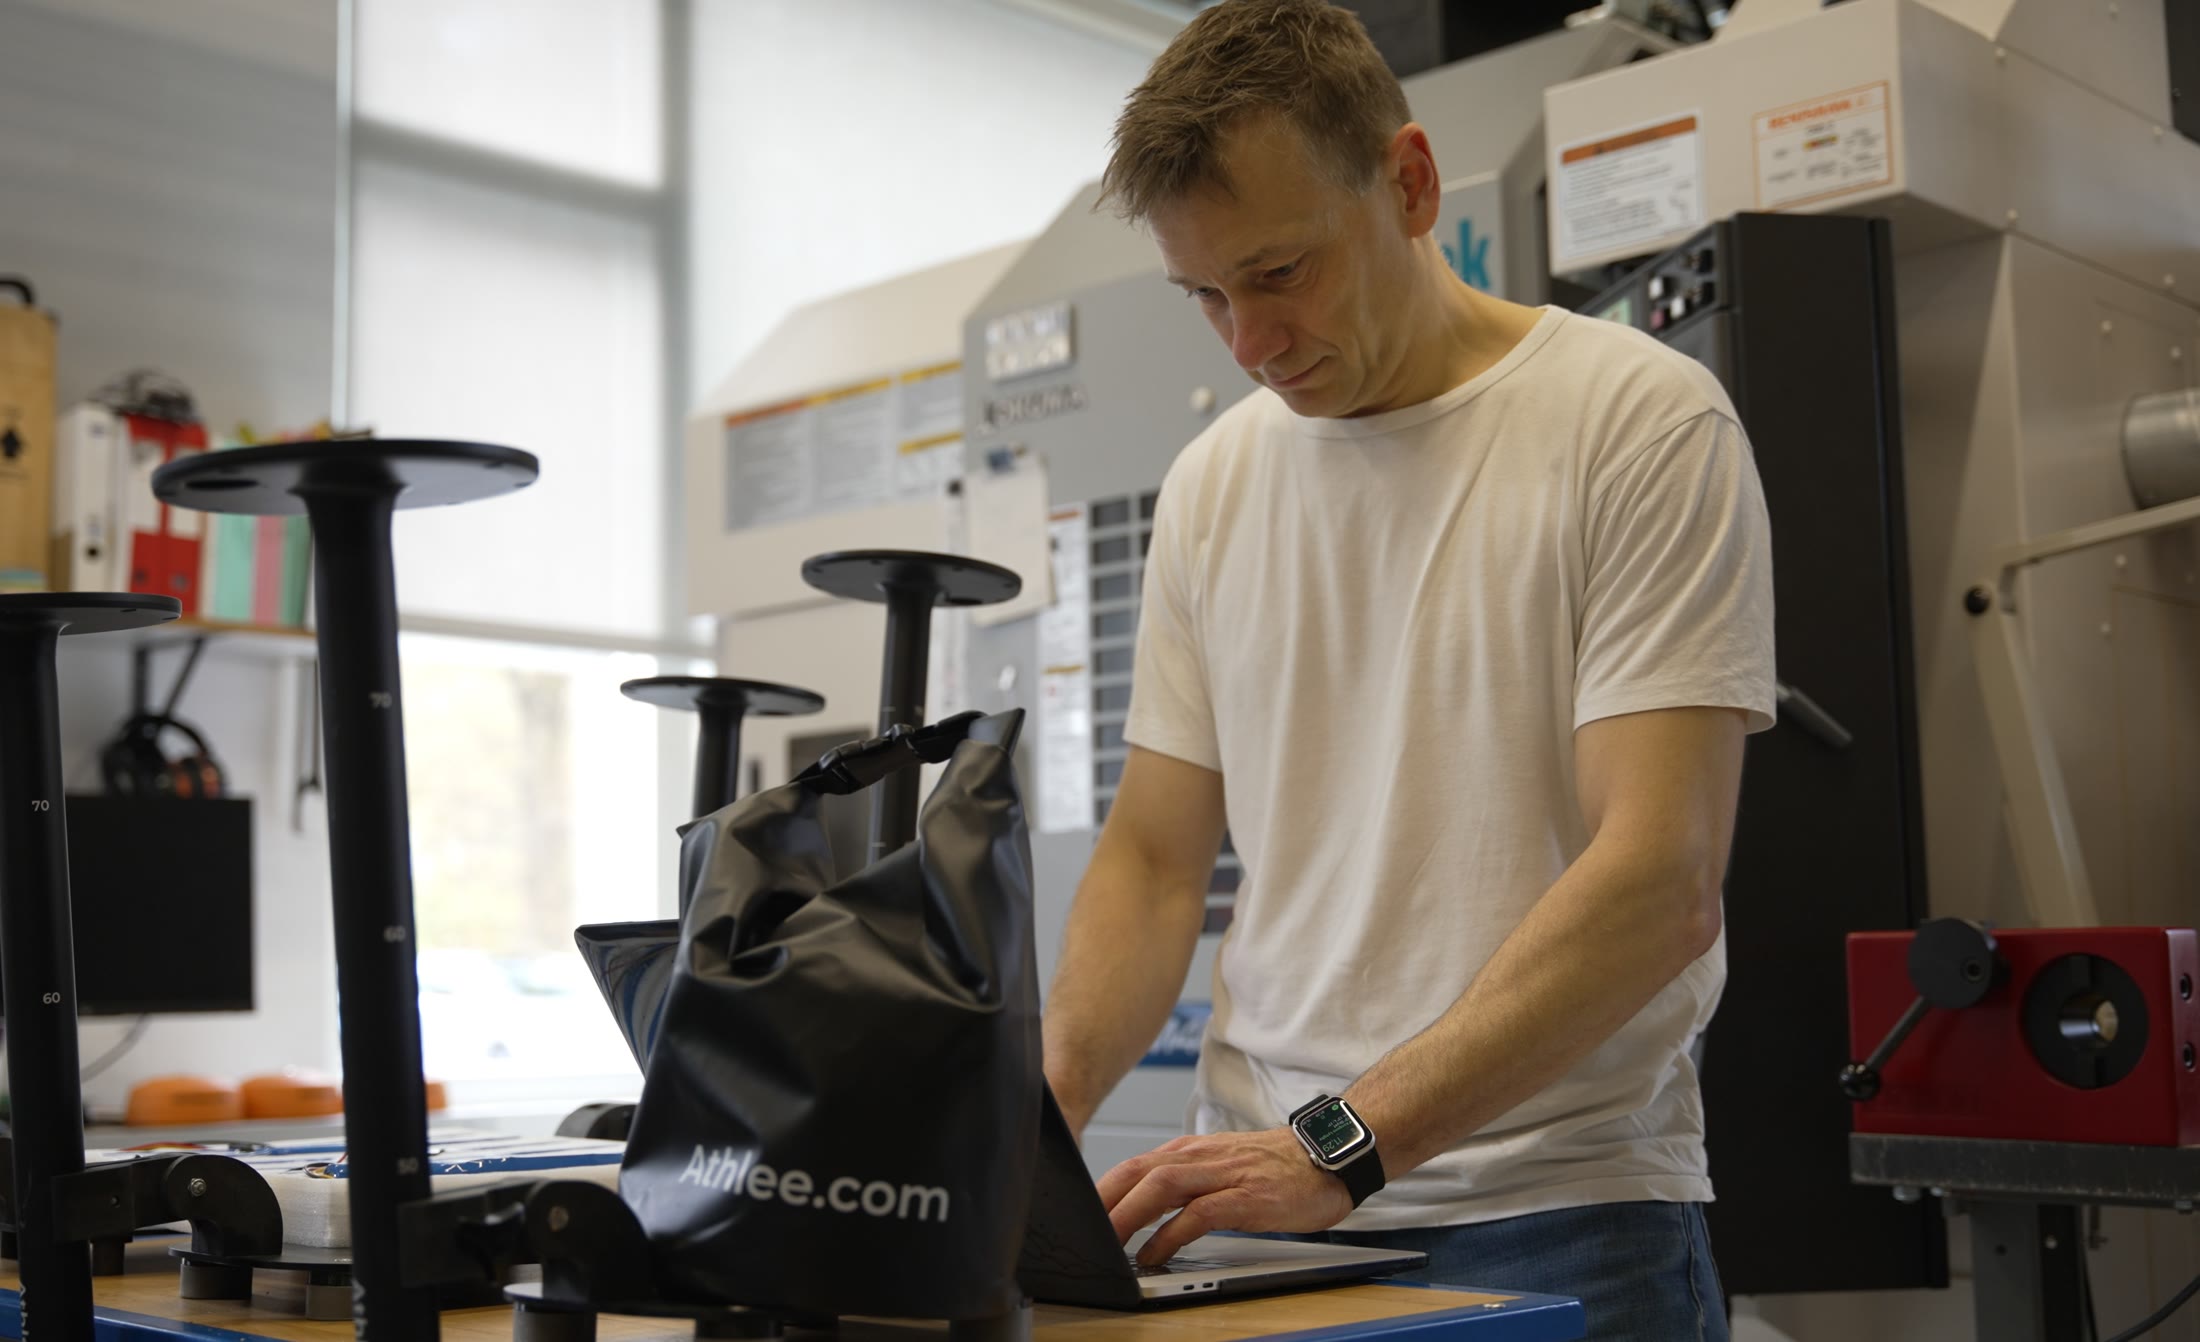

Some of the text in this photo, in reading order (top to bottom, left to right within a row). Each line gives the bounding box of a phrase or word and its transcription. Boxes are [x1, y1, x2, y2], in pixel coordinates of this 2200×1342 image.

[368, 691, 392, 709] 70
[31, 799, 50, 812] 70
[384, 925, 406, 942] 60
[42, 991, 61, 1004] 60
[679, 1144, 949, 1222] Athlee.com
